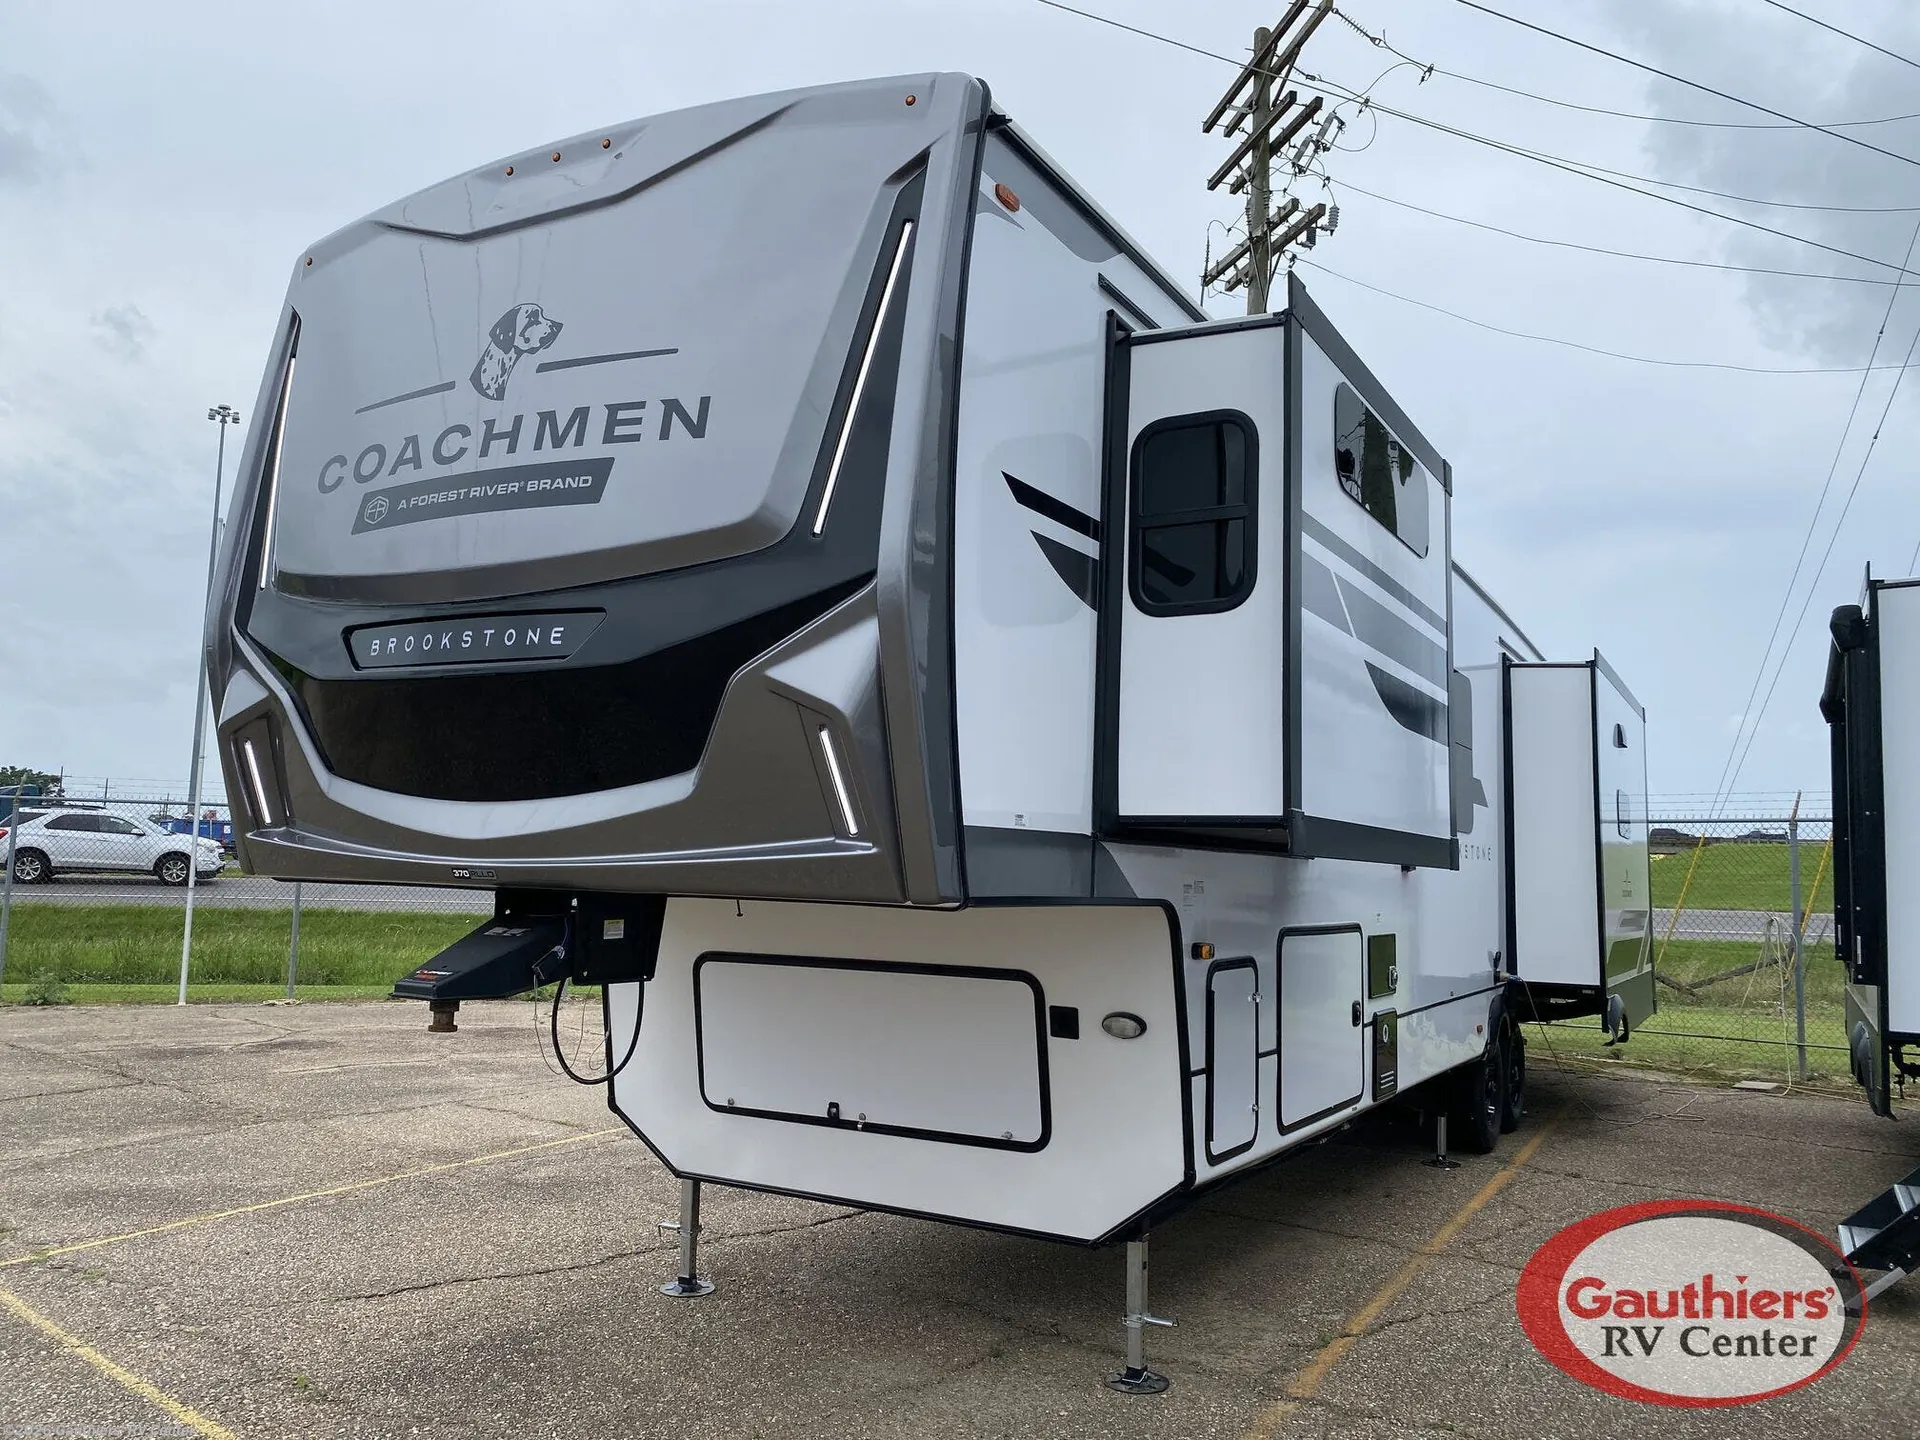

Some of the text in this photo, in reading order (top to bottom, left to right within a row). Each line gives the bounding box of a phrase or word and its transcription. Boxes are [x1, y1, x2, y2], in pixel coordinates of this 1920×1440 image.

[318, 396, 711, 494] COACHMEN
[397, 499, 407, 511] A
[410, 488, 469, 508] FOREST
[526, 475, 593, 492] BRAND
[370, 626, 565, 656] BROOKSTONE
